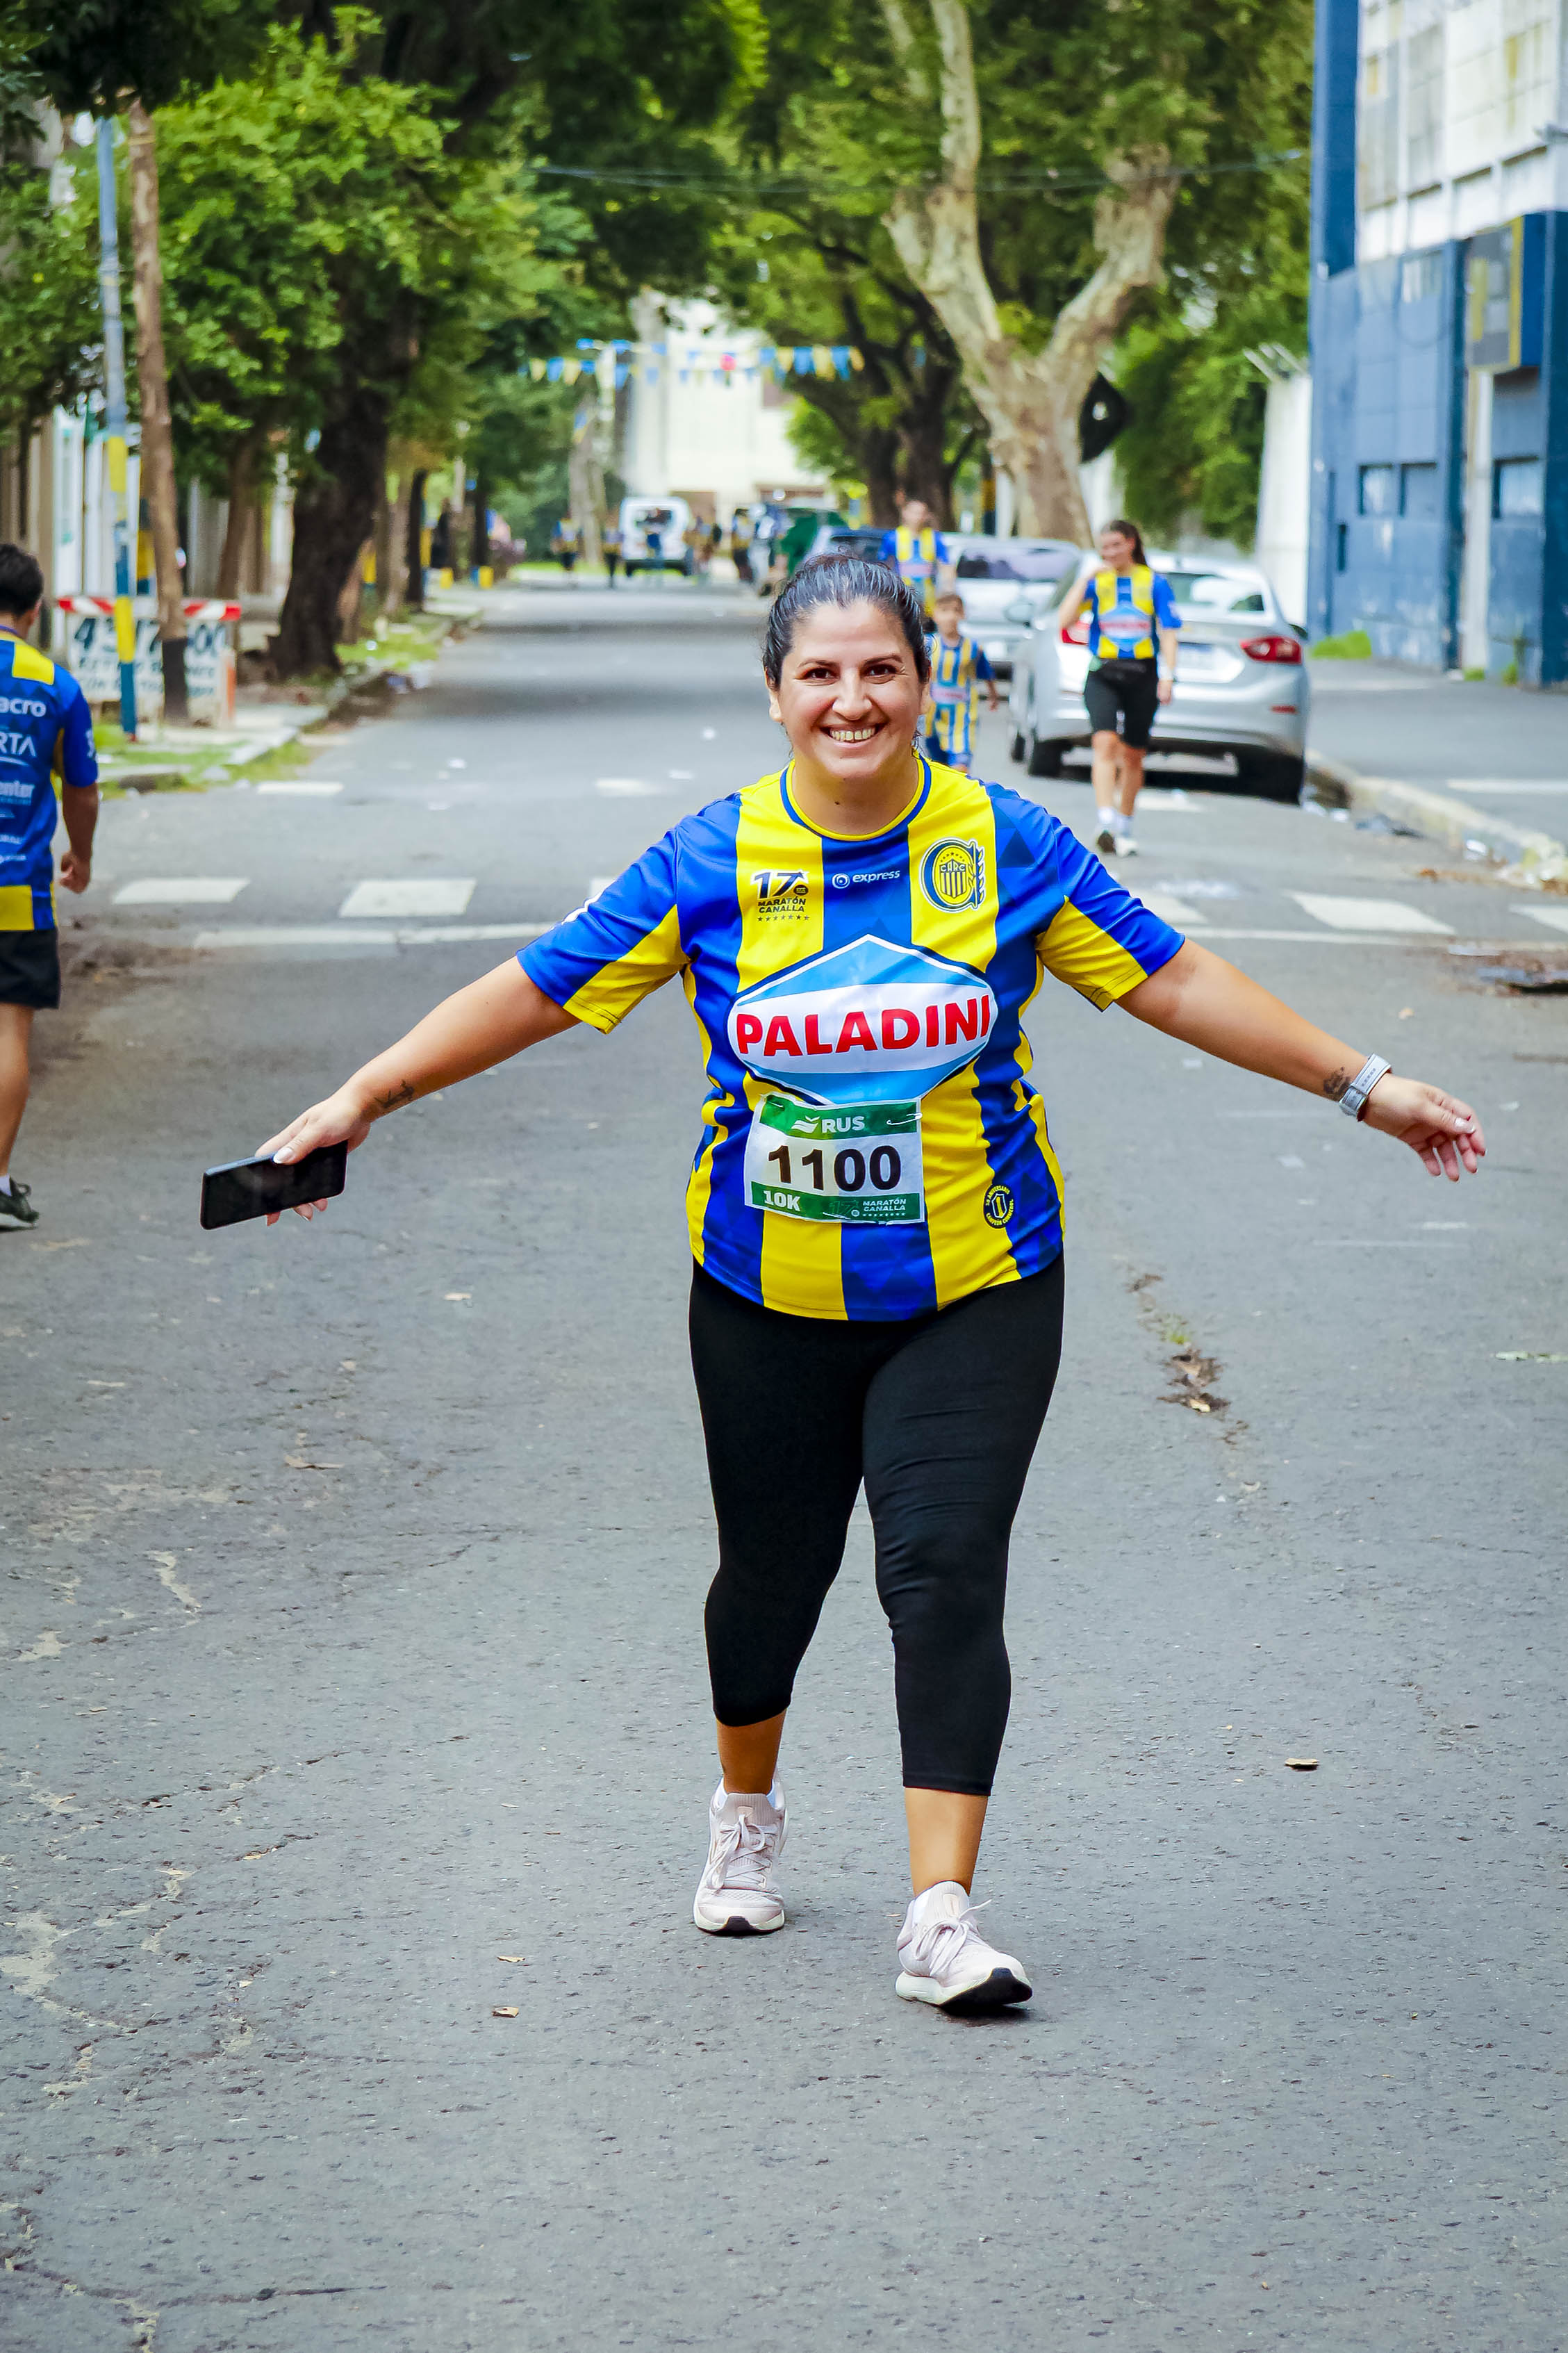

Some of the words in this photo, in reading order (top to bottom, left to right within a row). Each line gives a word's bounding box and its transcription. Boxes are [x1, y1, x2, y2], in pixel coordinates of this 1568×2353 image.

[852, 870, 900, 883] express
[758, 896, 806, 907] MARATÓN
[759, 905, 804, 913] CANALLA
[736, 995, 990, 1056] PALADINI
[822, 1116, 865, 1133] RUS
[768, 1145, 901, 1192] 1100
[763, 1190, 800, 1211] 10K
[863, 1197, 906, 1206] MARATÓN
